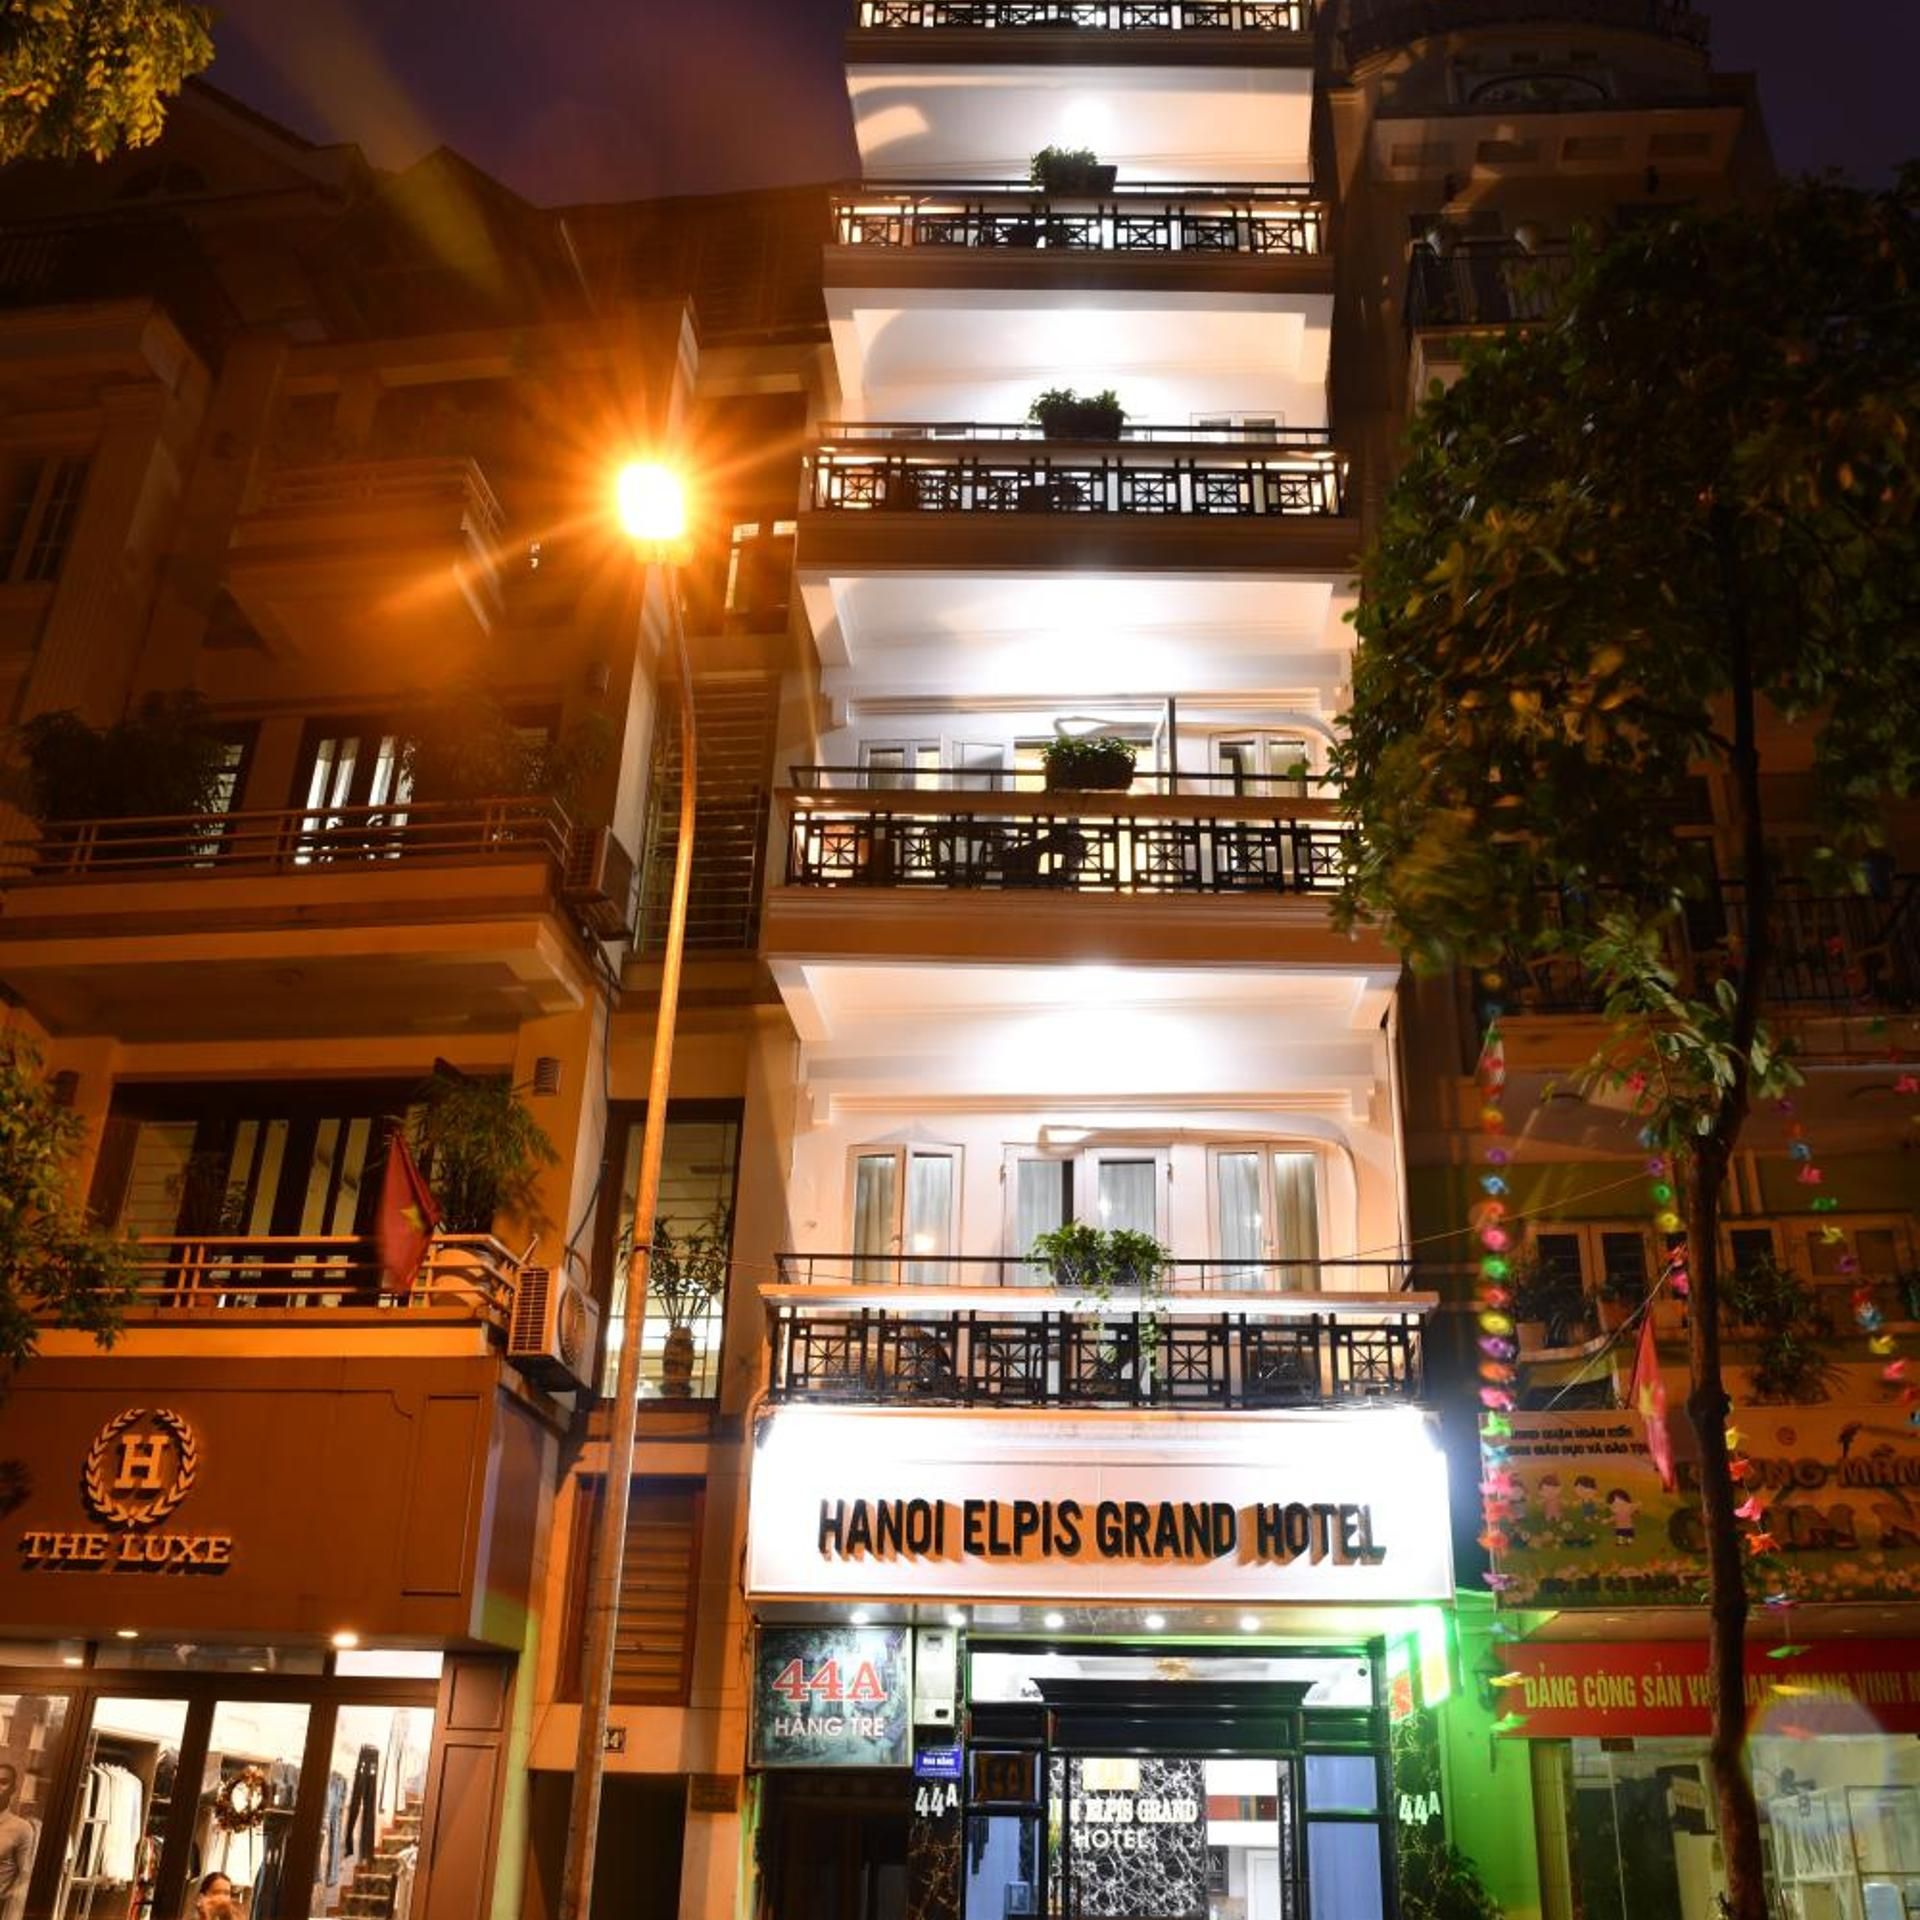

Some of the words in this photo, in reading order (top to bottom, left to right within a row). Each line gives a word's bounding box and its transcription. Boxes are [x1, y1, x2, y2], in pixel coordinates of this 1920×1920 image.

[114, 1435, 169, 1489] H
[818, 1498, 945, 1557] HANOI
[963, 1499, 1083, 1558] ELPIS
[1096, 1500, 1237, 1559] GRAND
[1256, 1501, 1387, 1559] HOTEL
[24, 1531, 108, 1560] THE
[118, 1533, 232, 1564] LUXE
[771, 1657, 889, 1702] 44A
[1525, 1661, 1577, 1708] ĐẢNG
[1583, 1669, 1636, 1716] CỘNG
[1642, 1661, 1683, 1708] SẢN
[774, 1710, 844, 1737] HÀNG
[850, 1715, 885, 1737] TRE
[915, 1783, 958, 1817] 44A
[1137, 1798, 1198, 1823] GRAND
[1399, 1790, 1441, 1826] 44A
[1074, 1828, 1150, 1850] HOTEL
